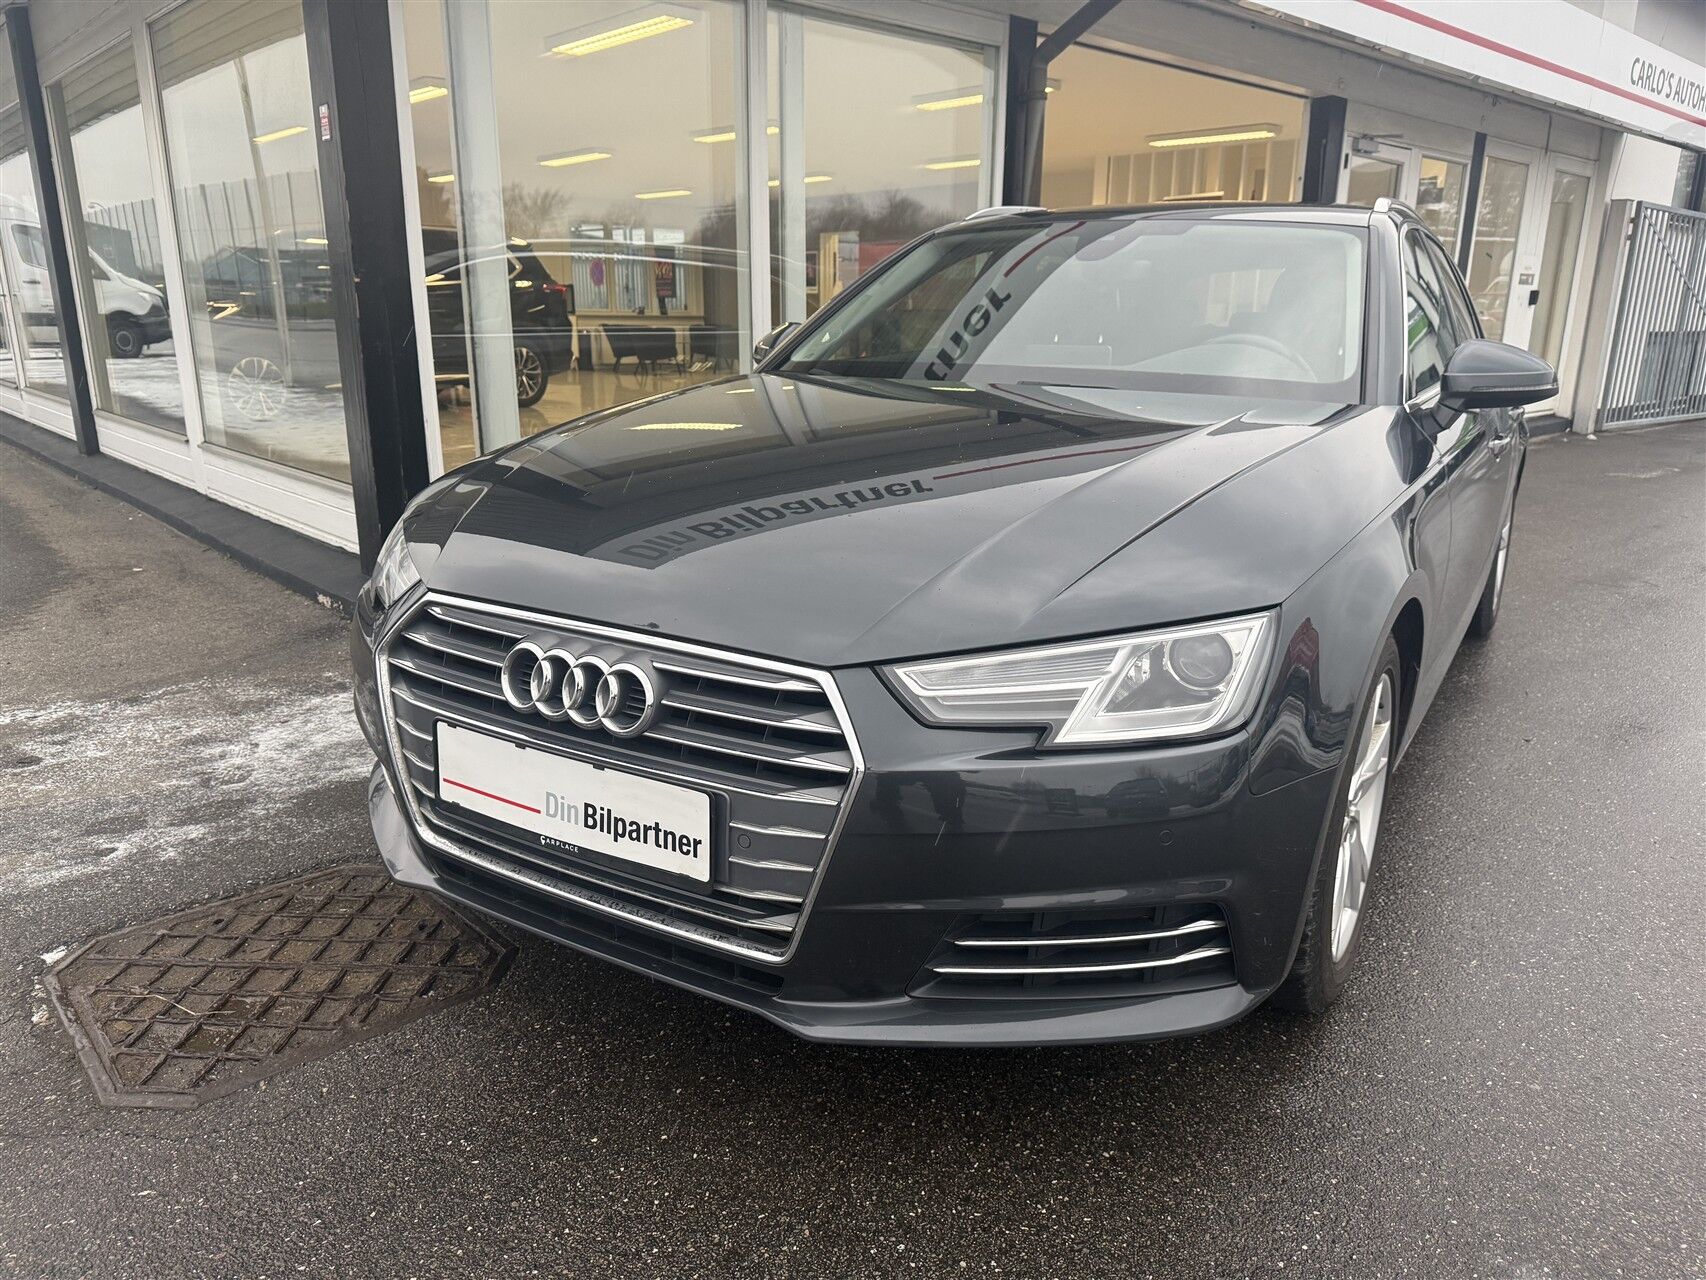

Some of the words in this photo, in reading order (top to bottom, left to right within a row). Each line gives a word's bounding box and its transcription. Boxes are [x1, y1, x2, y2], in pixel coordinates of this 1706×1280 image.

[1631, 57, 1674, 98] CARLO'S
[1673, 76, 1706, 112] AUTOH
[545, 791, 579, 826] Din
[583, 802, 702, 859] Bilpartner
